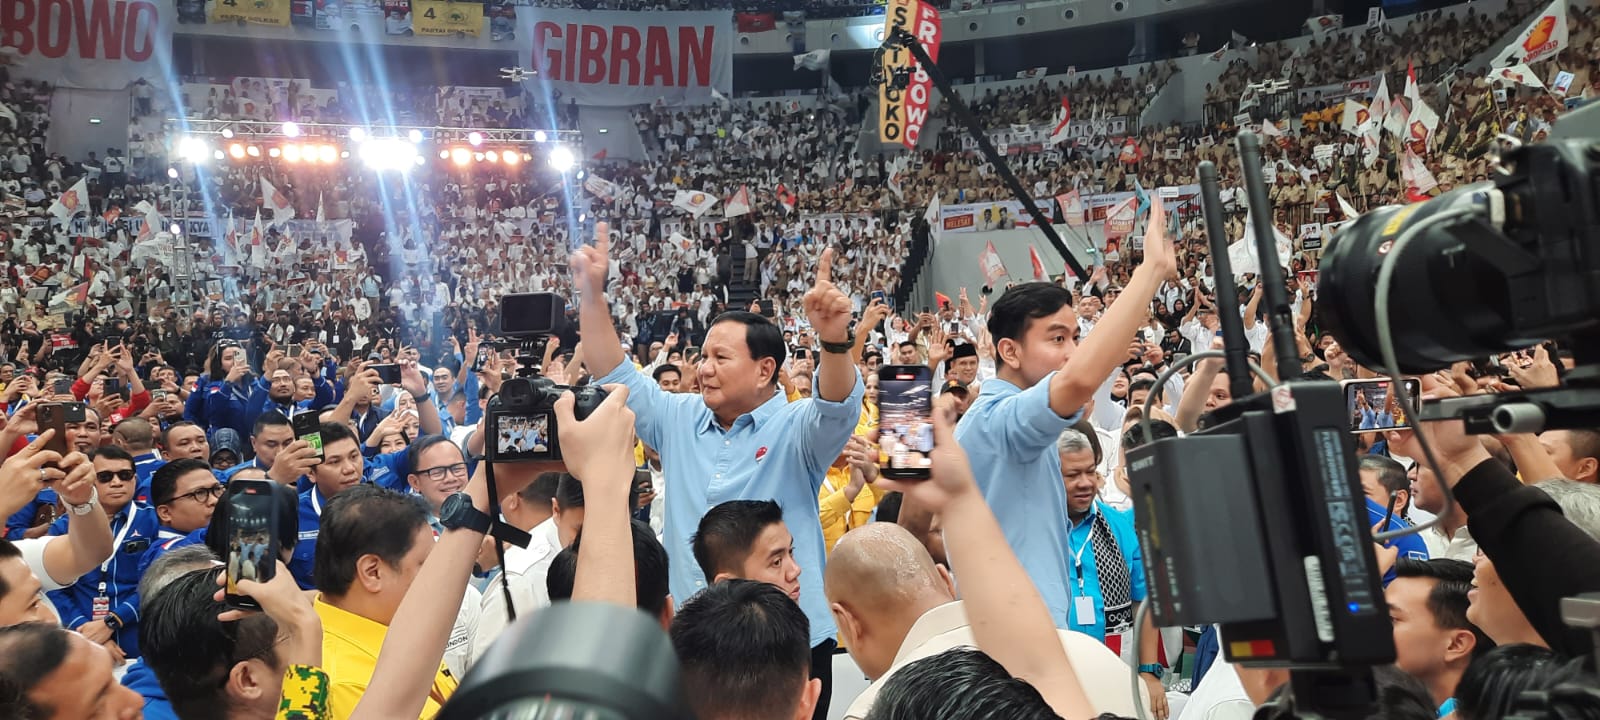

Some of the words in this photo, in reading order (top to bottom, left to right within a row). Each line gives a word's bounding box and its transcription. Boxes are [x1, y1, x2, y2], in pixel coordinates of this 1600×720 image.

[0, 0, 159, 62] BOWO
[424, 7, 437, 20] 4
[532, 21, 715, 87] GIBRAN
[905, 7, 937, 146] PRBOWO
[447, 636, 468, 648] NDON
